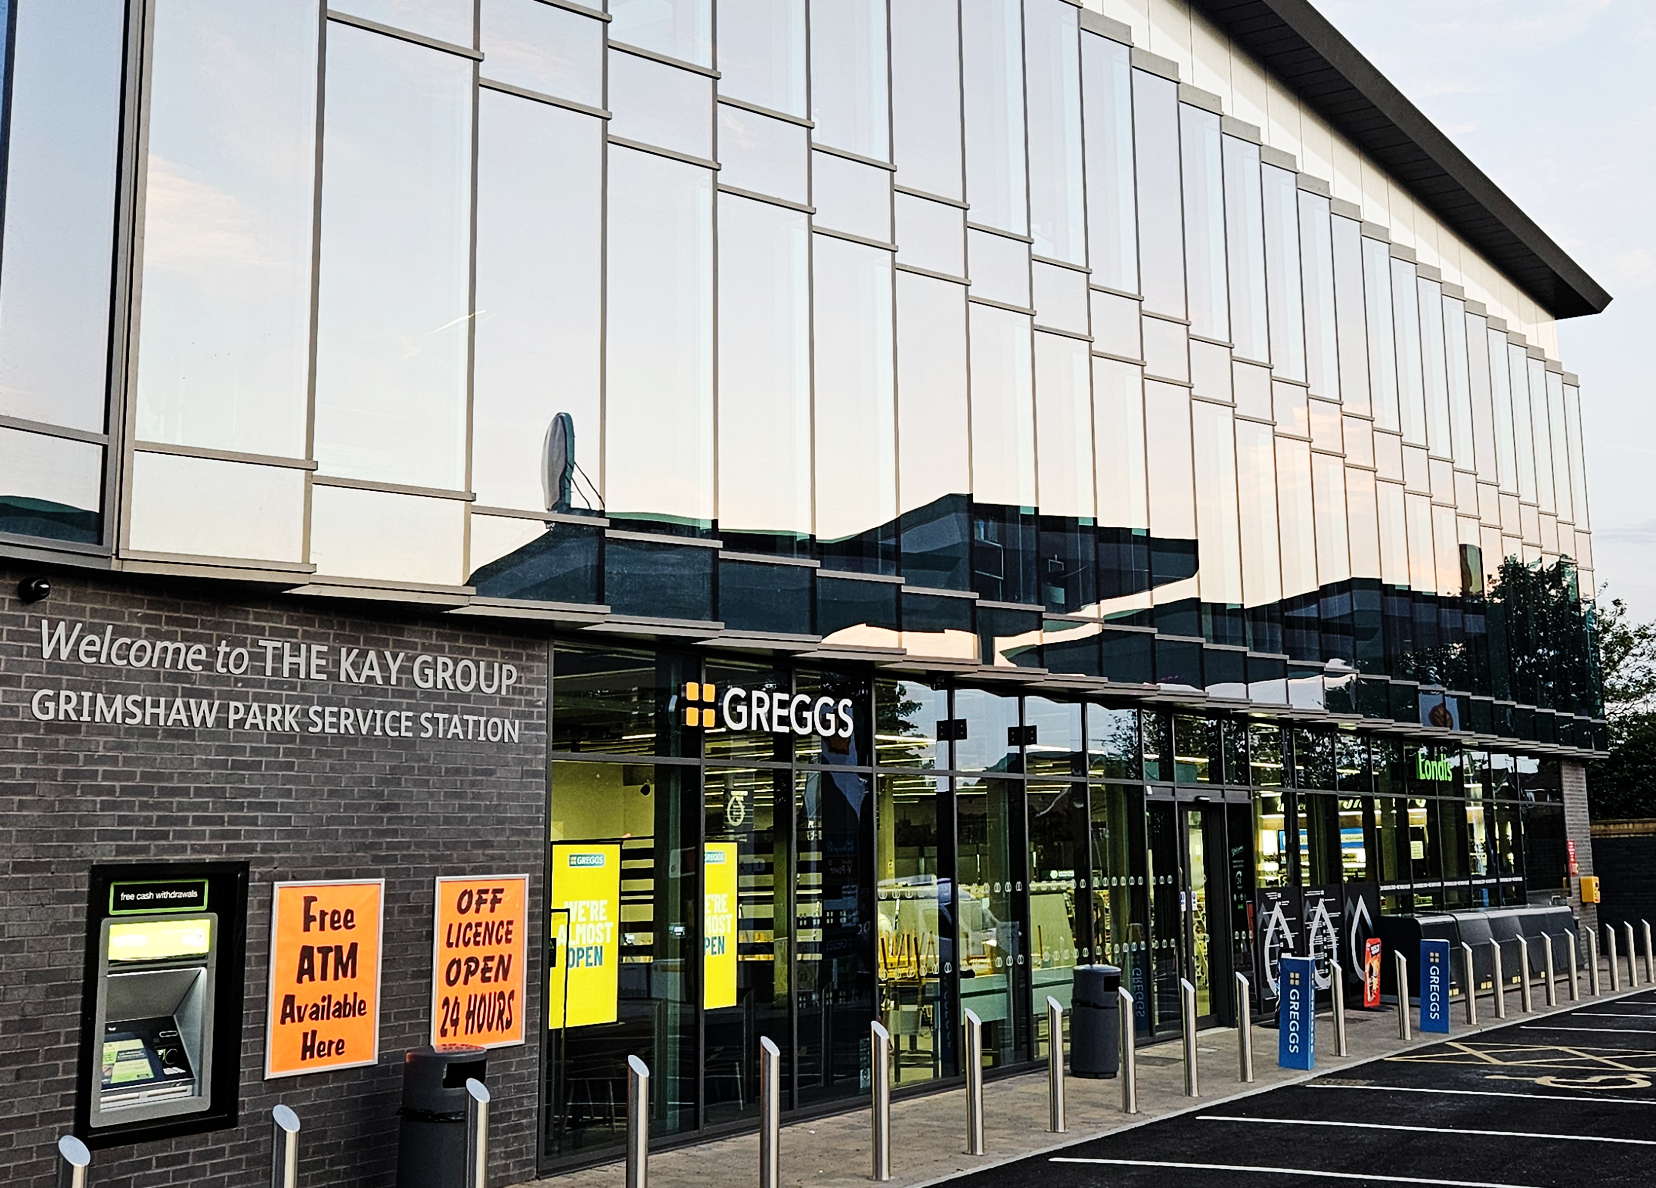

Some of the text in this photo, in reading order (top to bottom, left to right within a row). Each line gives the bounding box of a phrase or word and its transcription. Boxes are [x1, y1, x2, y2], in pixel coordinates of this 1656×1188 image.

[41, 619, 518, 695] Welcome to THE KAY GROUP
[31, 689, 520, 743] GRIMSHAW PARK SERVICE STATION
[723, 687, 854, 738] GREGGS
[1418, 751, 1453, 782] Londis
[577, 855, 603, 865] GREGGS
[120, 890, 198, 901] free cash withdrawals
[456, 888, 505, 915] OFF
[564, 900, 608, 922] WE'RE
[706, 894, 728, 914] E'RE
[302, 895, 356, 933] Free
[706, 914, 732, 935] MOST
[445, 919, 514, 948] LICENCE
[557, 922, 614, 947] ALMOST
[705, 936, 725, 955] PEN
[296, 942, 359, 984] ATM
[445, 953, 513, 987] OPEN
[568, 946, 603, 968] OPEN
[1429, 965, 1440, 1020] GREGGS
[280, 992, 367, 1025] Available
[440, 989, 515, 1038] 24 HOURS
[1288, 988, 1300, 1054] GREGGS
[300, 1029, 345, 1061] Here
